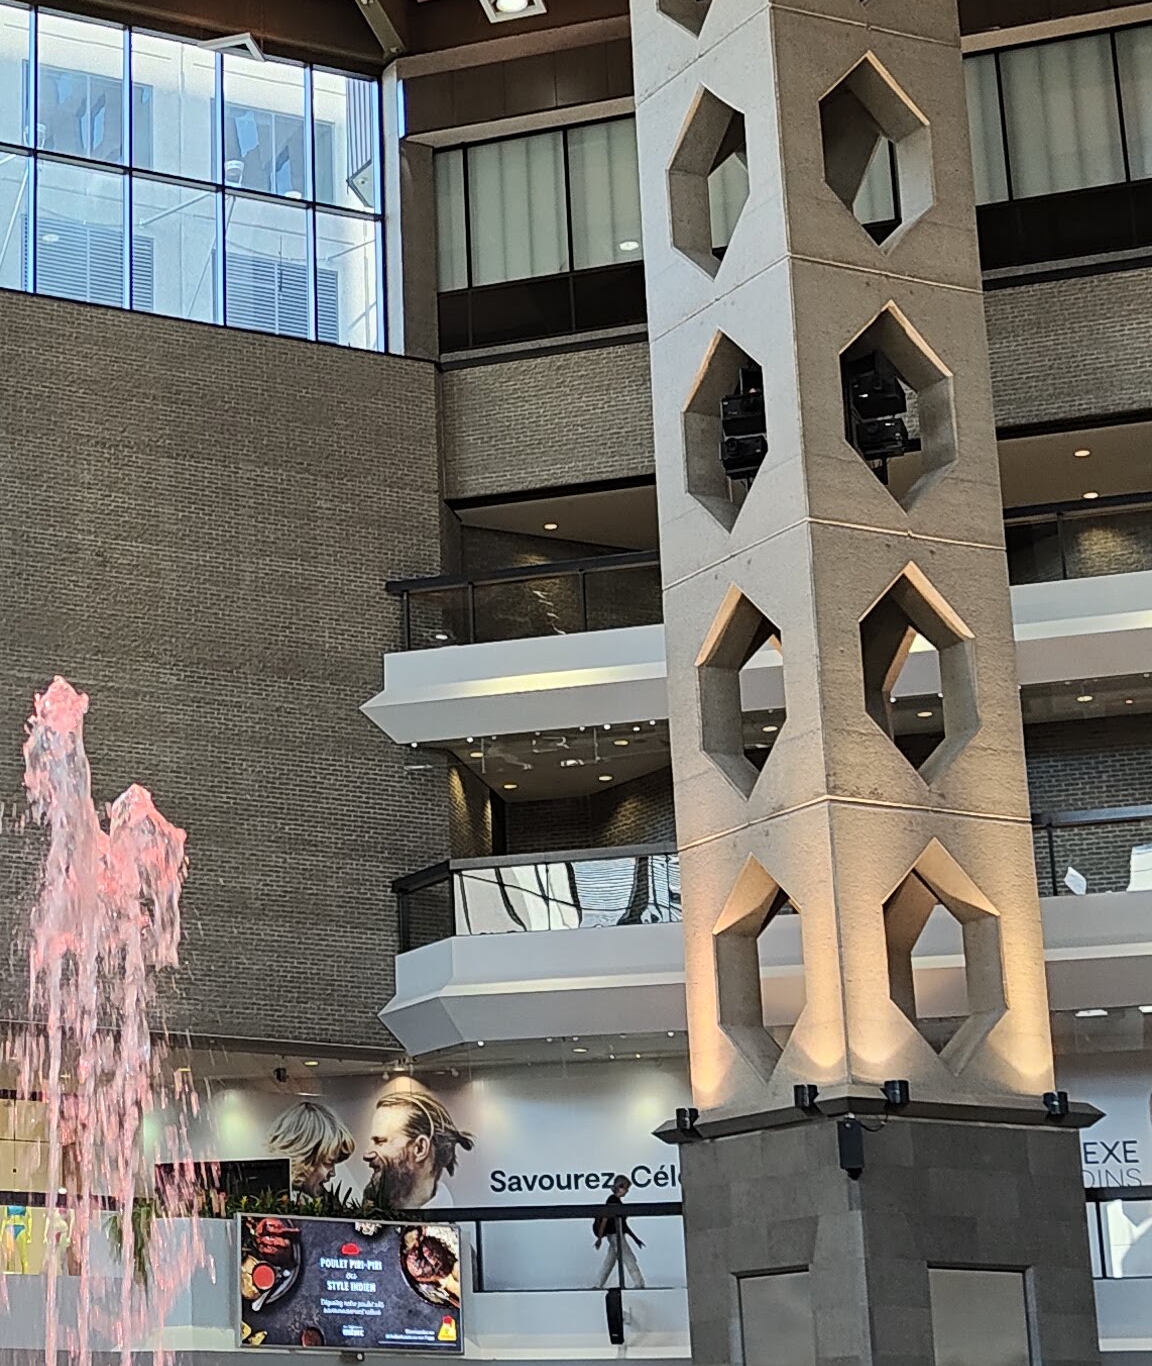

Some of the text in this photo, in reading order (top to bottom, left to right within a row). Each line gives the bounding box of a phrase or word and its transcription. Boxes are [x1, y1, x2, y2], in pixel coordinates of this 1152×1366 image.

[1083, 1140, 1139, 1164] EXE
[490, 1163, 682, 1193] Savourez Cél
[320, 1257, 383, 1271] POULET PIRI-PIRI
[326, 1280, 376, 1293] STYLE INDIEN
